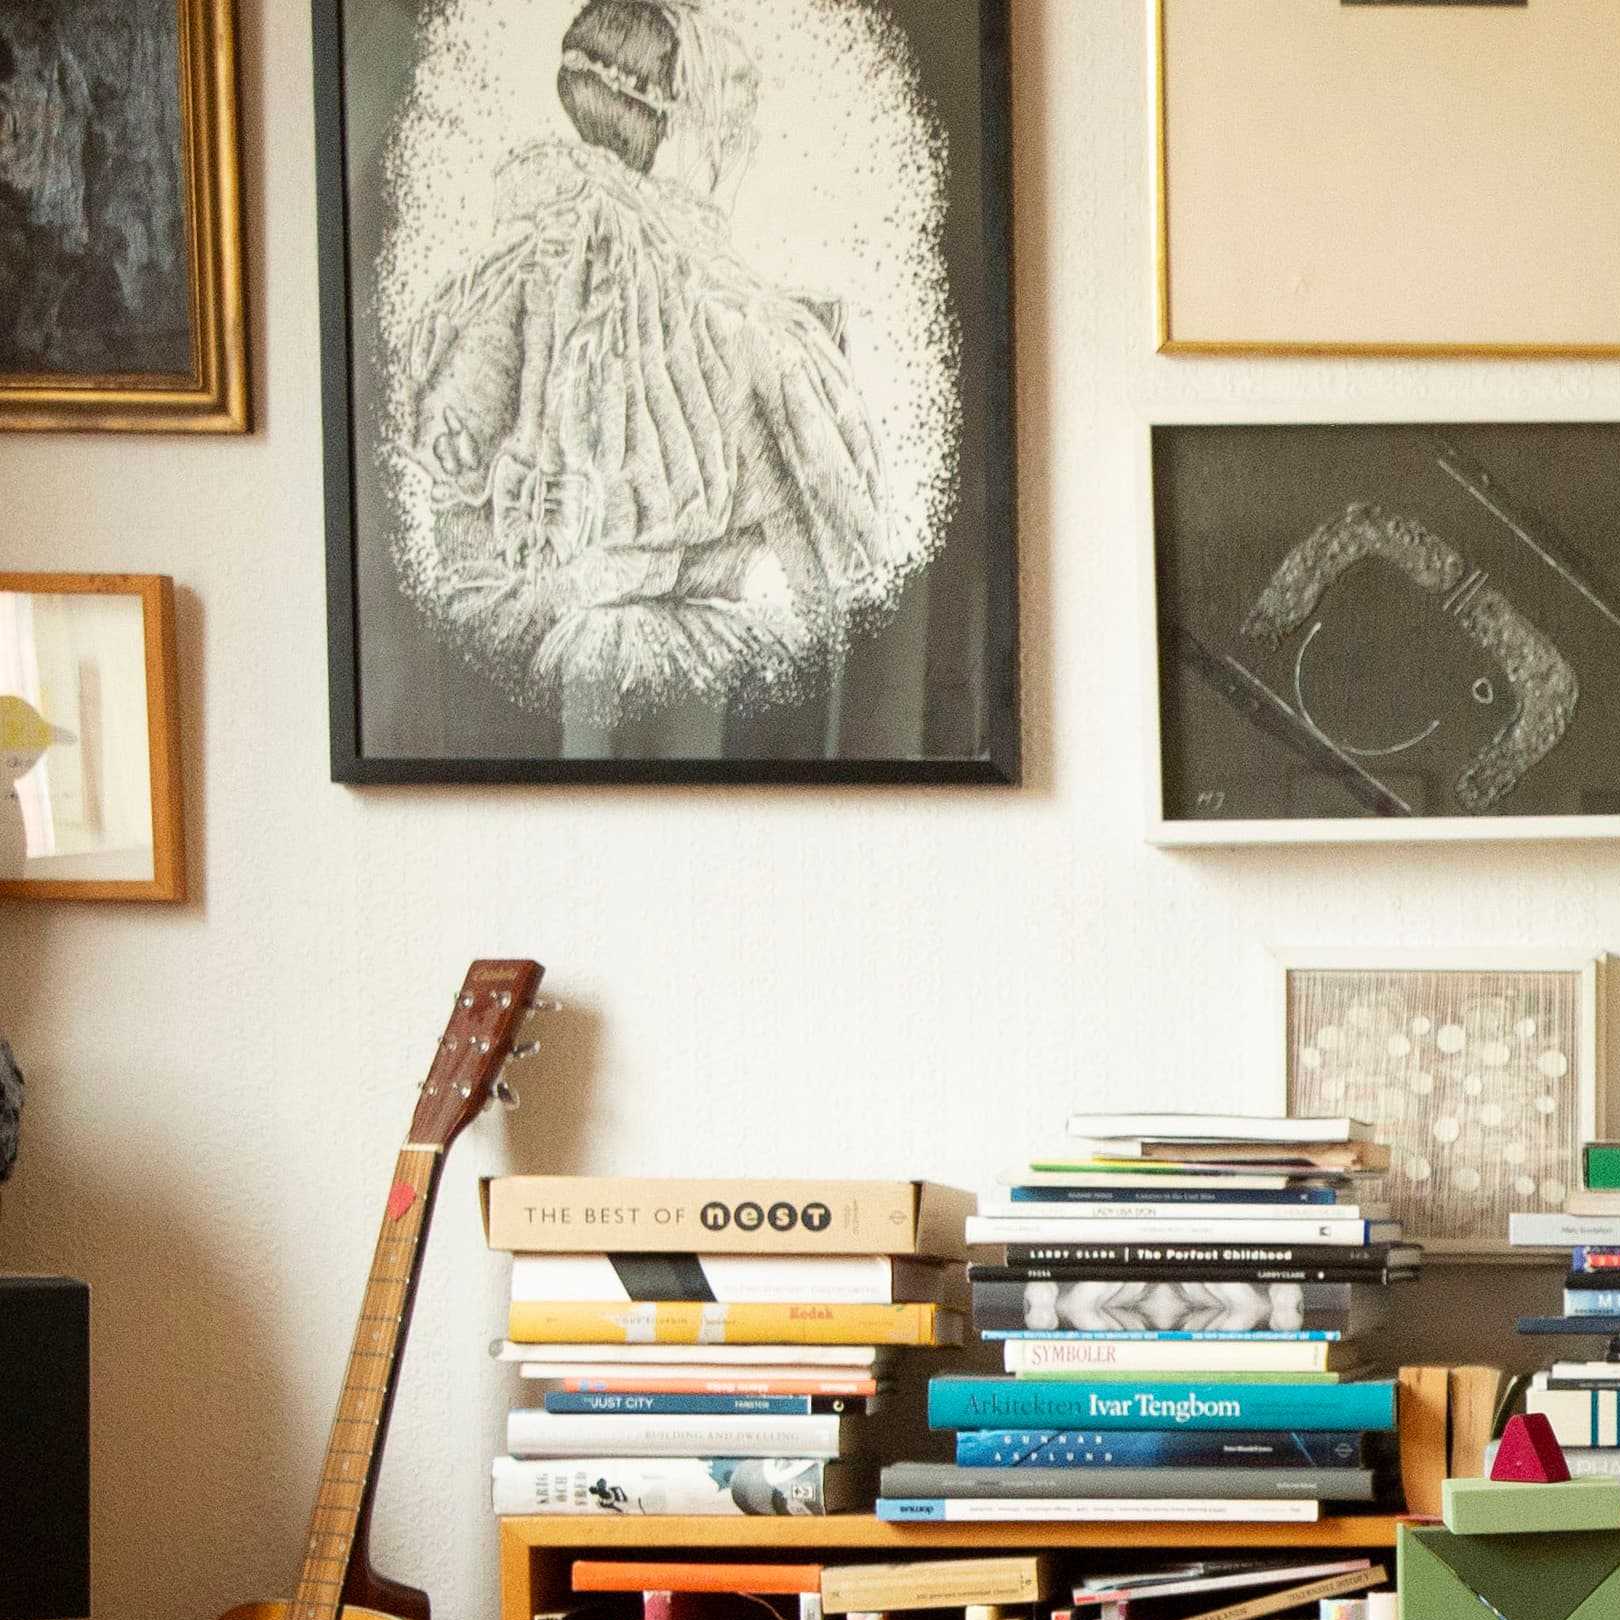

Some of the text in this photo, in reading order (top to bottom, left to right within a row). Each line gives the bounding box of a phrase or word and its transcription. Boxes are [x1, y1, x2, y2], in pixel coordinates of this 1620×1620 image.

[525, 1207, 573, 1224] THE
[585, 1207, 640, 1224] BEST
[654, 1208, 686, 1224] OF
[1075, 1250, 1115, 1259] CLARK
[1137, 1249, 1161, 1259] The
[1166, 1249, 1218, 1260] Perfect
[1222, 1249, 1292, 1260] Childhood
[1031, 1344, 1117, 1365] SYMBOLER
[591, 1398, 654, 1409] JUST CITY
[964, 1394, 1241, 1422] Arkitekten Ivar Tengbom
[645, 1431, 800, 1441] BUILDING AND DWELLING
[1004, 1434, 1103, 1445] GUNNAR
[994, 1451, 1113, 1462] ASPLUND
